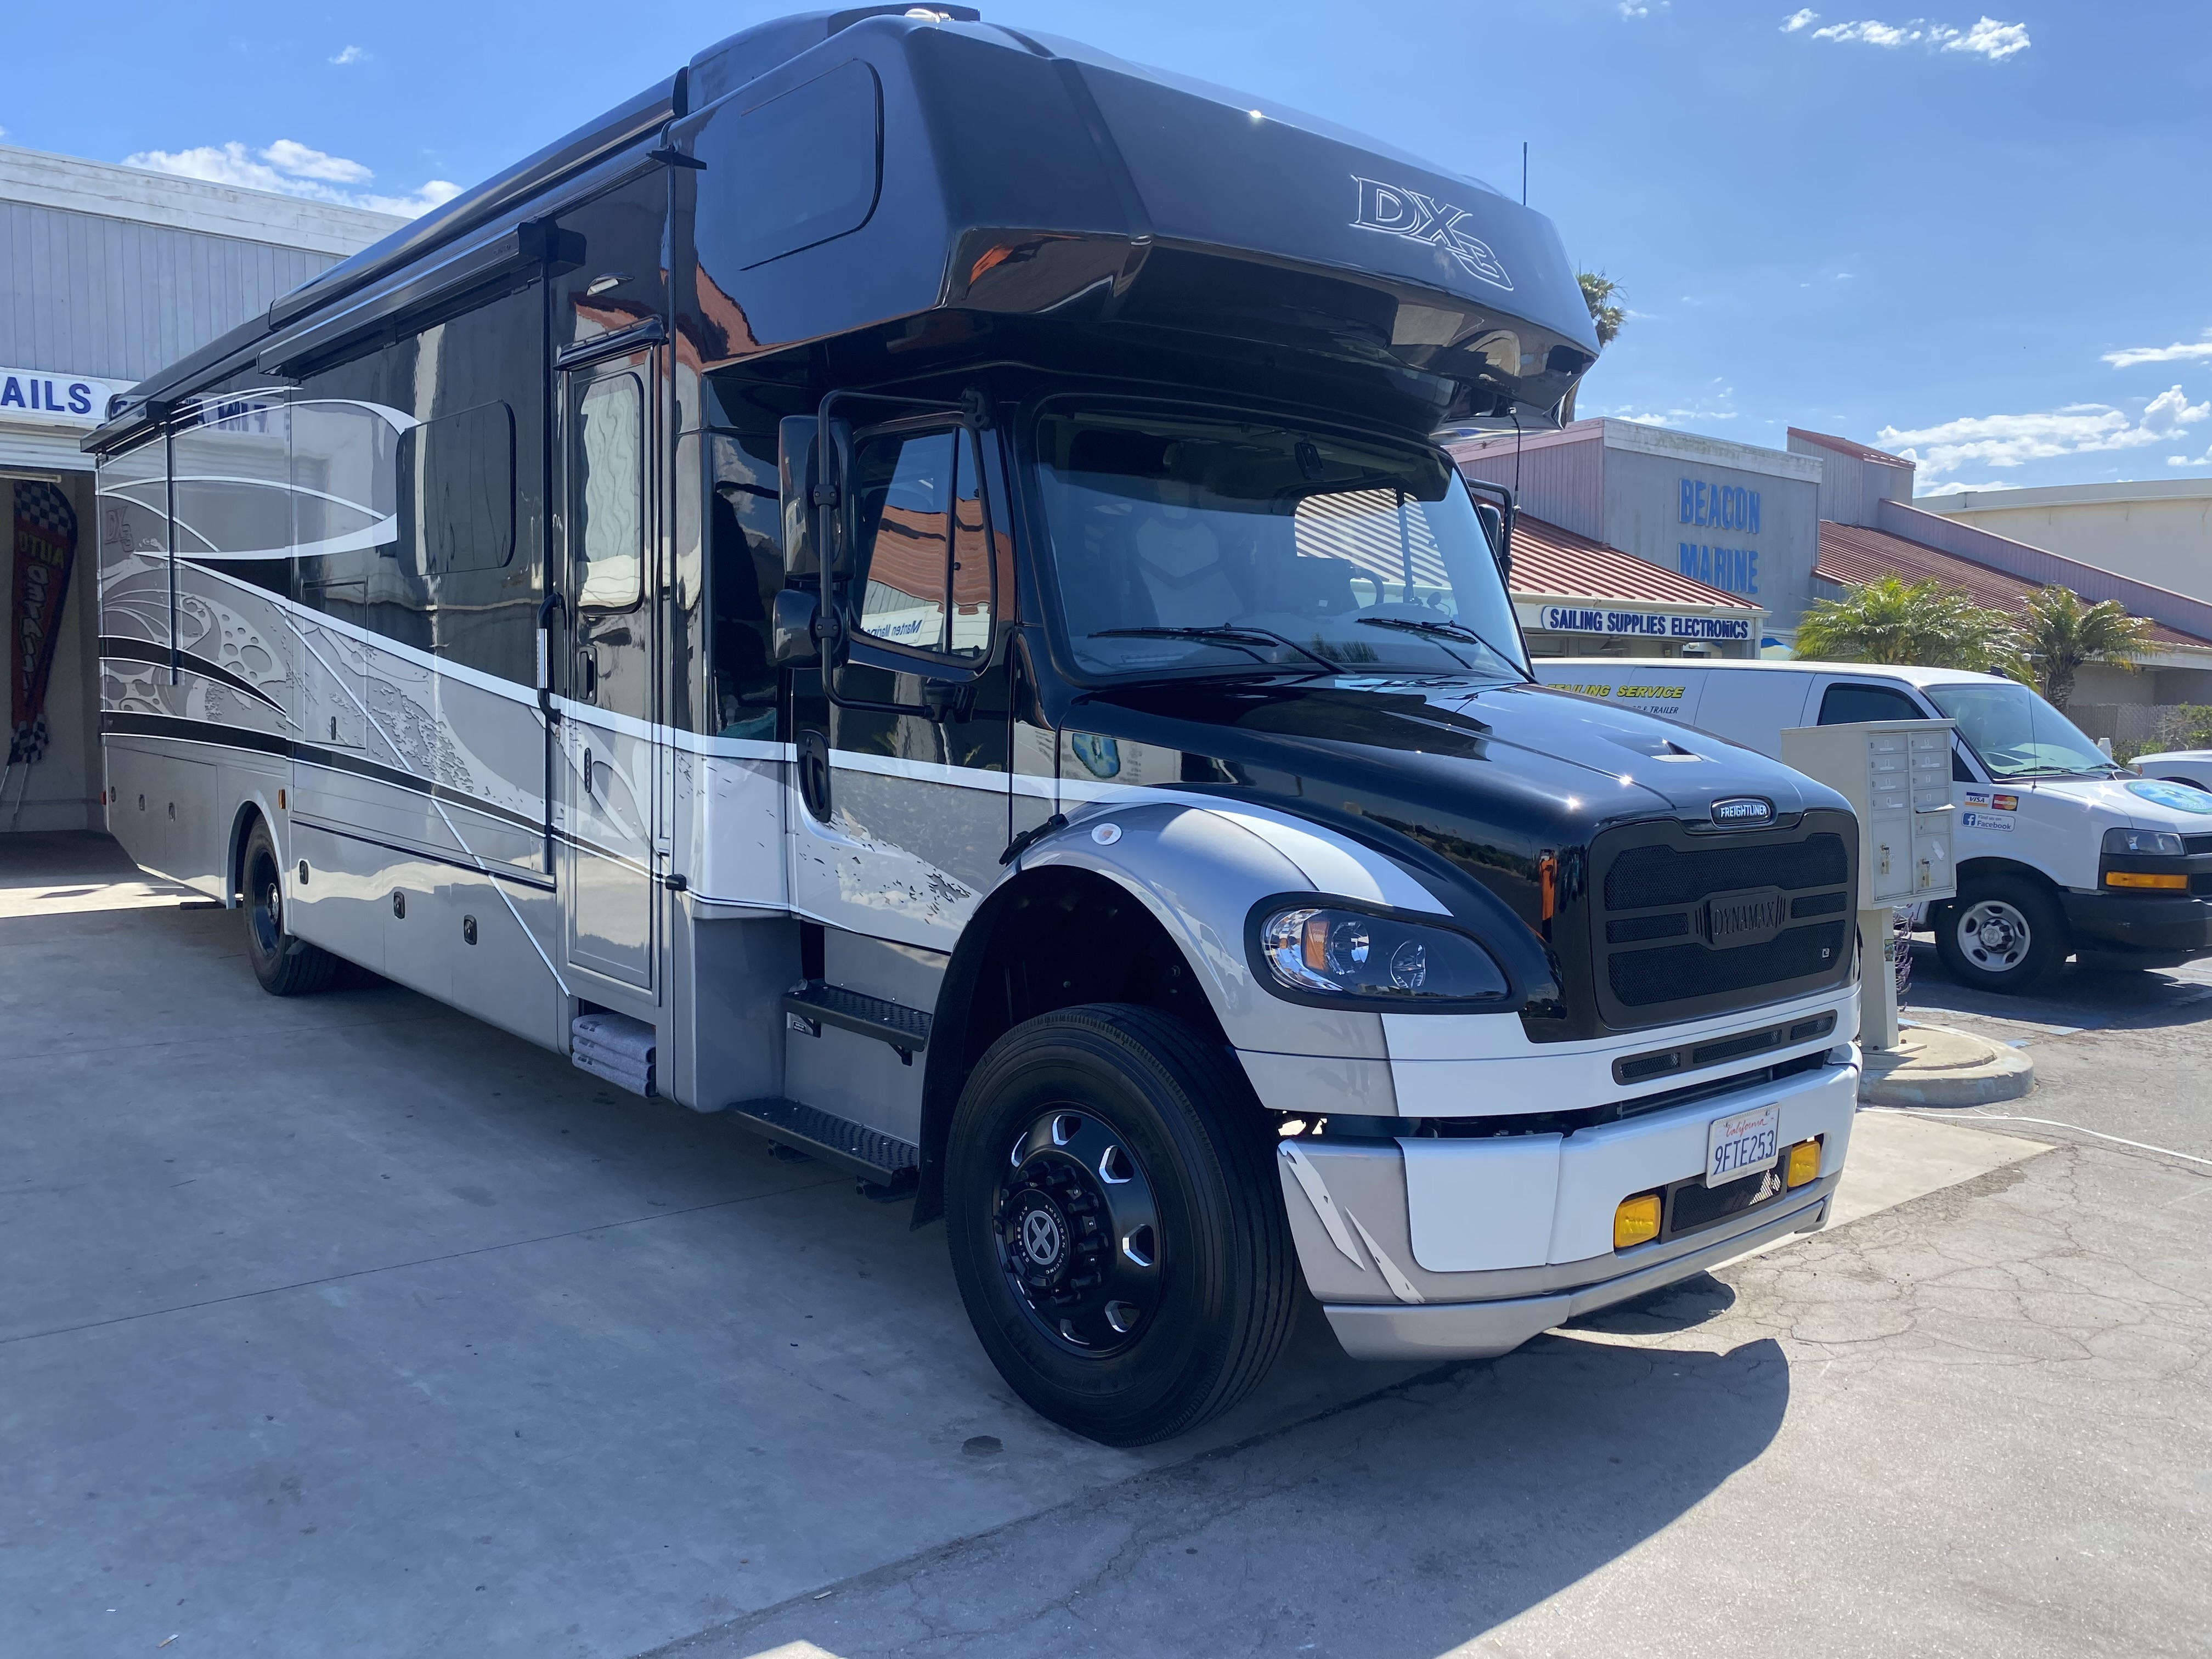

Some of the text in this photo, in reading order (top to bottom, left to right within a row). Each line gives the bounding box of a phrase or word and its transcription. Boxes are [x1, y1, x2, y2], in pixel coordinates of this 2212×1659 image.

[1, 376, 92, 414] AILS
[1679, 478, 1760, 534] BEACON
[1678, 543, 1759, 594] MARINE
[1550, 608, 1748, 639] SAILING SUPPLIES ELECTRONICS
[1616, 685, 1685, 698] SERVICE
[1650, 706, 1679, 714] TRAILER
[1720, 804, 1767, 818] FREIGHTLINER
[1977, 821, 2011, 830] Facebook
[1714, 901, 1775, 935] DYNAMAX
[1725, 1118, 1768, 1138] California
[1713, 1130, 1775, 1175] 9FTE253
